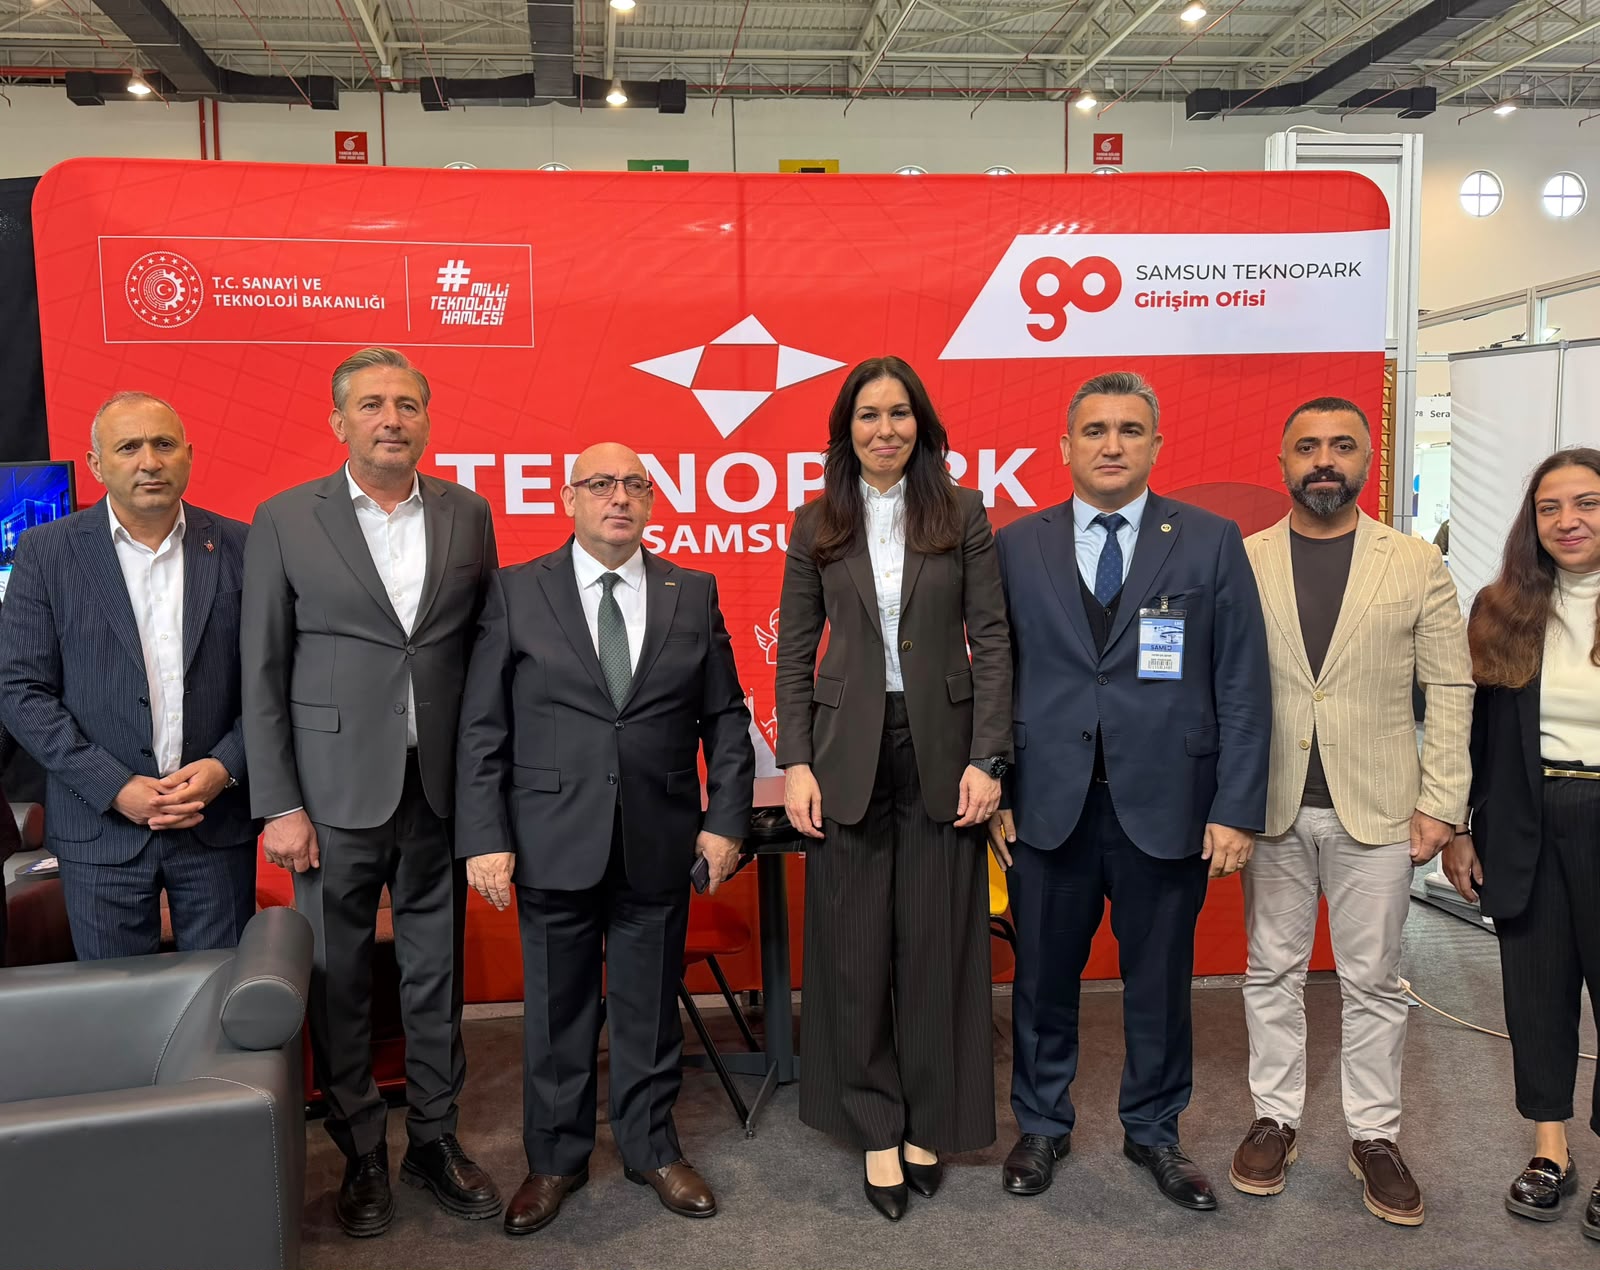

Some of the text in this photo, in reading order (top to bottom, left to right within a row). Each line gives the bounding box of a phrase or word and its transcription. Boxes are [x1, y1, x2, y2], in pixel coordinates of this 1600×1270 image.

[1136, 261, 1362, 281] SAMSUN TEKNOPARK
[212, 275, 322, 290] T.C. SANAYİ VE
[213, 293, 385, 309] TEKNOLOJİ BAKANLIĞI
[1020, 256, 1122, 342] go
[1134, 289, 1266, 312] Girişim Ofisi
